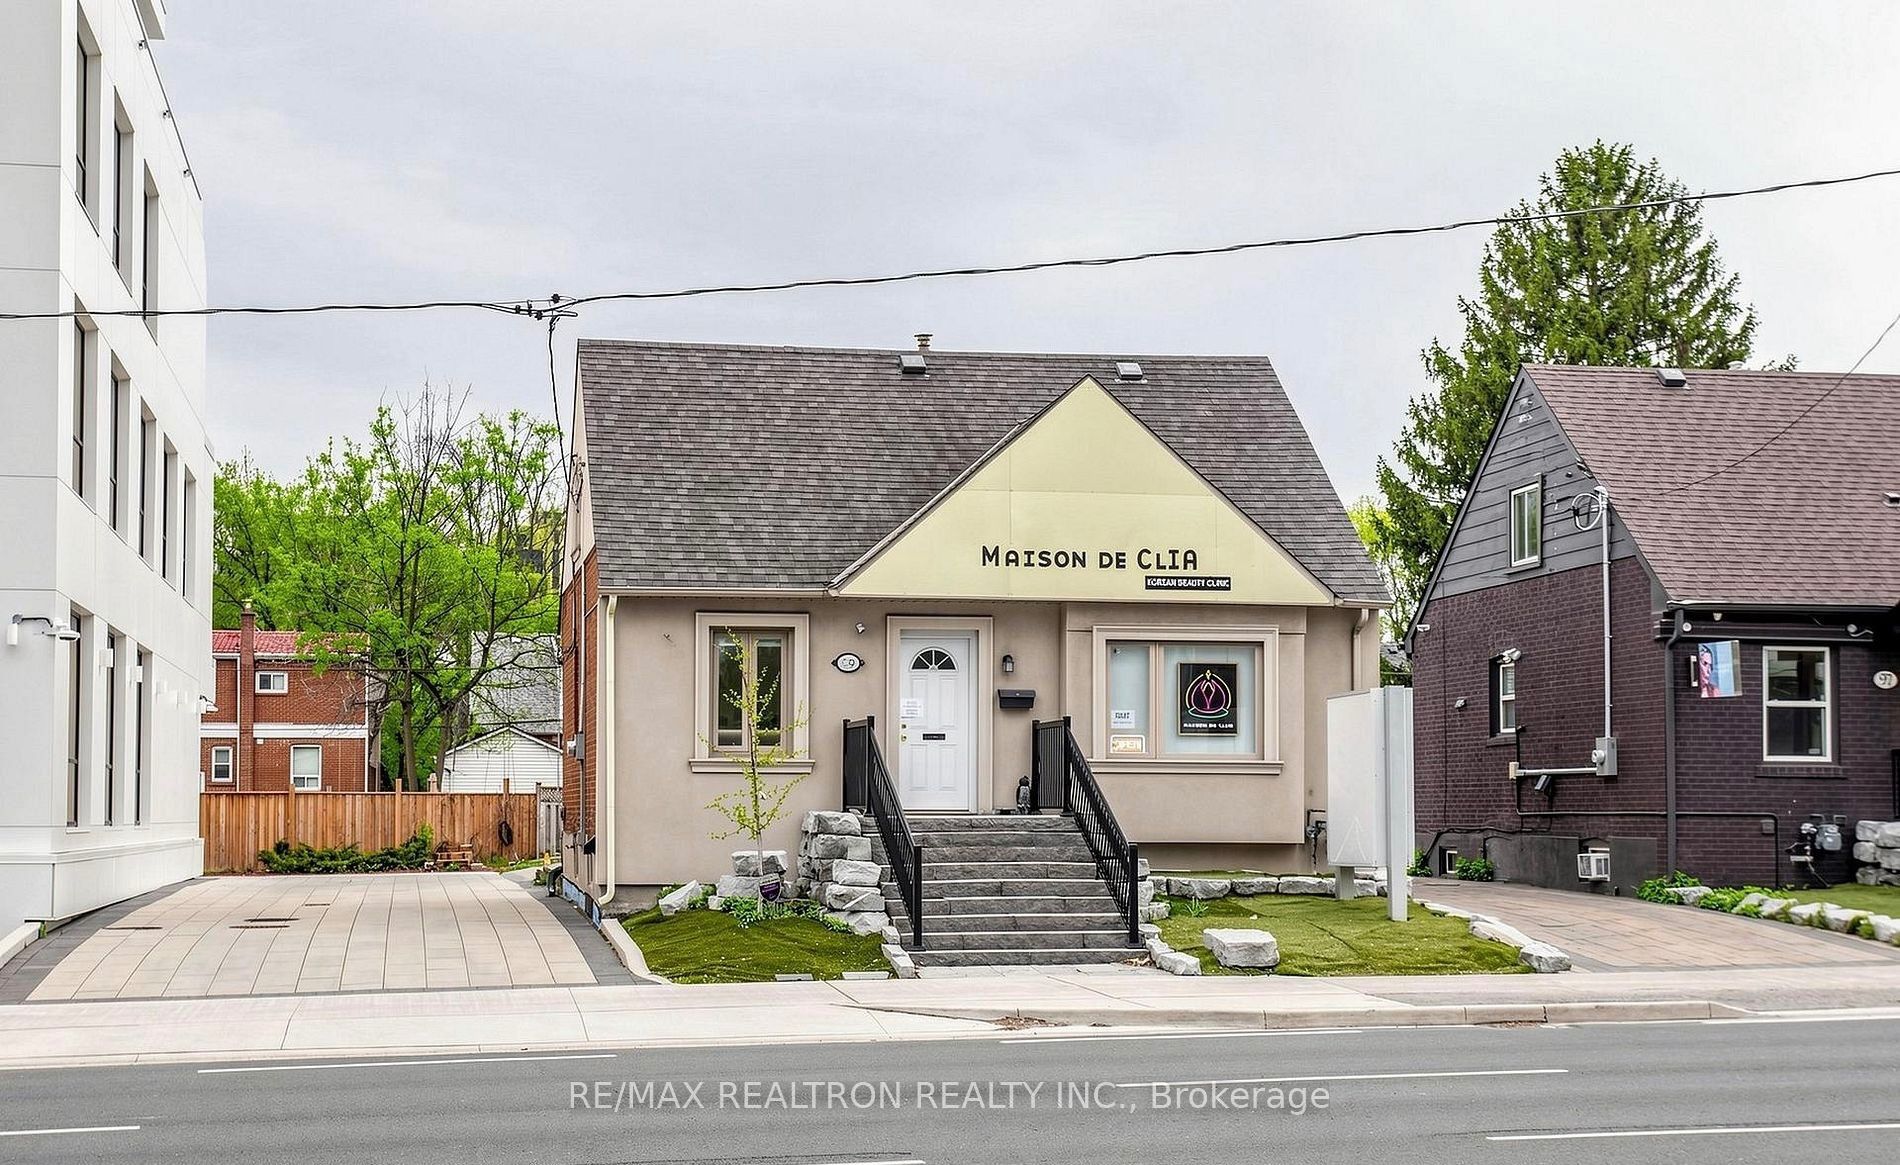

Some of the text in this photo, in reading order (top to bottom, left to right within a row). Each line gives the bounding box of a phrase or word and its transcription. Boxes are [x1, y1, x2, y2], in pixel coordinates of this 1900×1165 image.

[981, 545, 1198, 570] MAISON DE CLIA
[1177, 578, 1205, 587] BEAUTY
